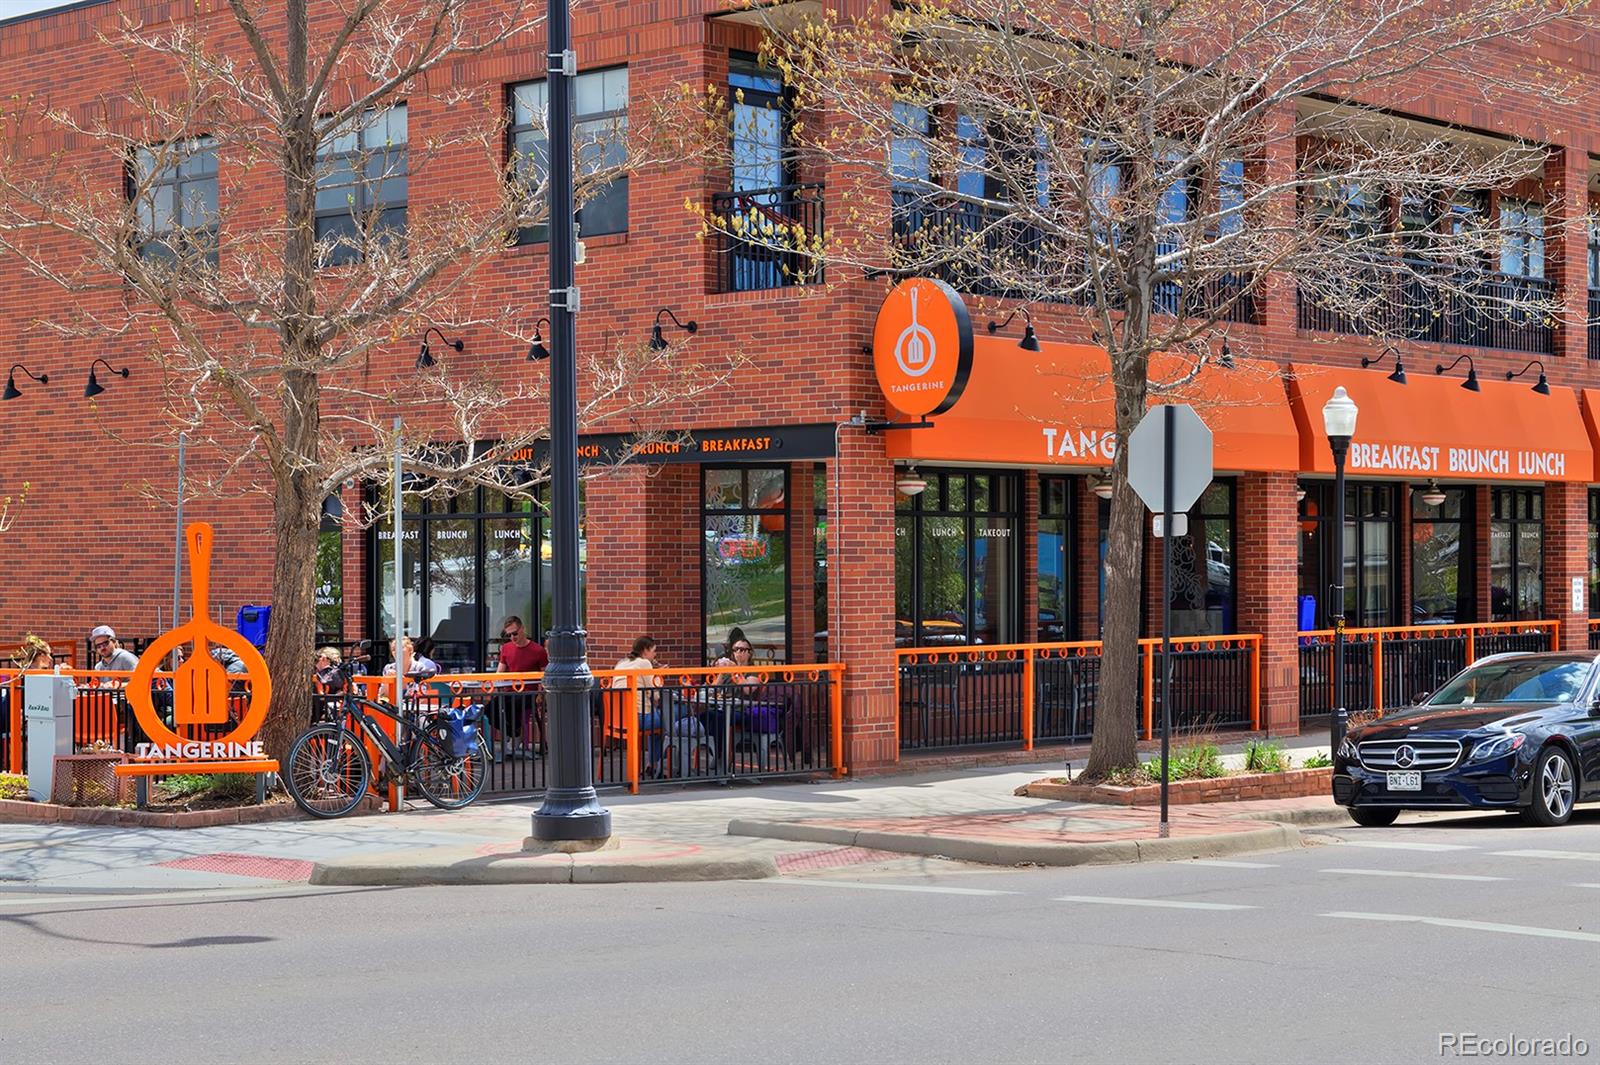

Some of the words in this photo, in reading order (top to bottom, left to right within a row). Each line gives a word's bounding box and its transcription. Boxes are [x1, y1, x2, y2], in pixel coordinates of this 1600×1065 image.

[890, 381, 945, 393] TANGERINE
[577, 445, 600, 458] NCH
[702, 437, 771, 452] BREAKFAST
[1351, 442, 1440, 472] BREAKFAST
[1448, 447, 1510, 474] BRUNCH
[1517, 451, 1566, 476] LUNCH
[377, 530, 420, 540] BREAFAST
[436, 530, 468, 540] BRUNCH
[494, 529, 521, 539] LUNCH
[931, 527, 957, 538] LUNCH
[978, 528, 1012, 538] TAKEOUT
[135, 741, 265, 760] TANGERINE
